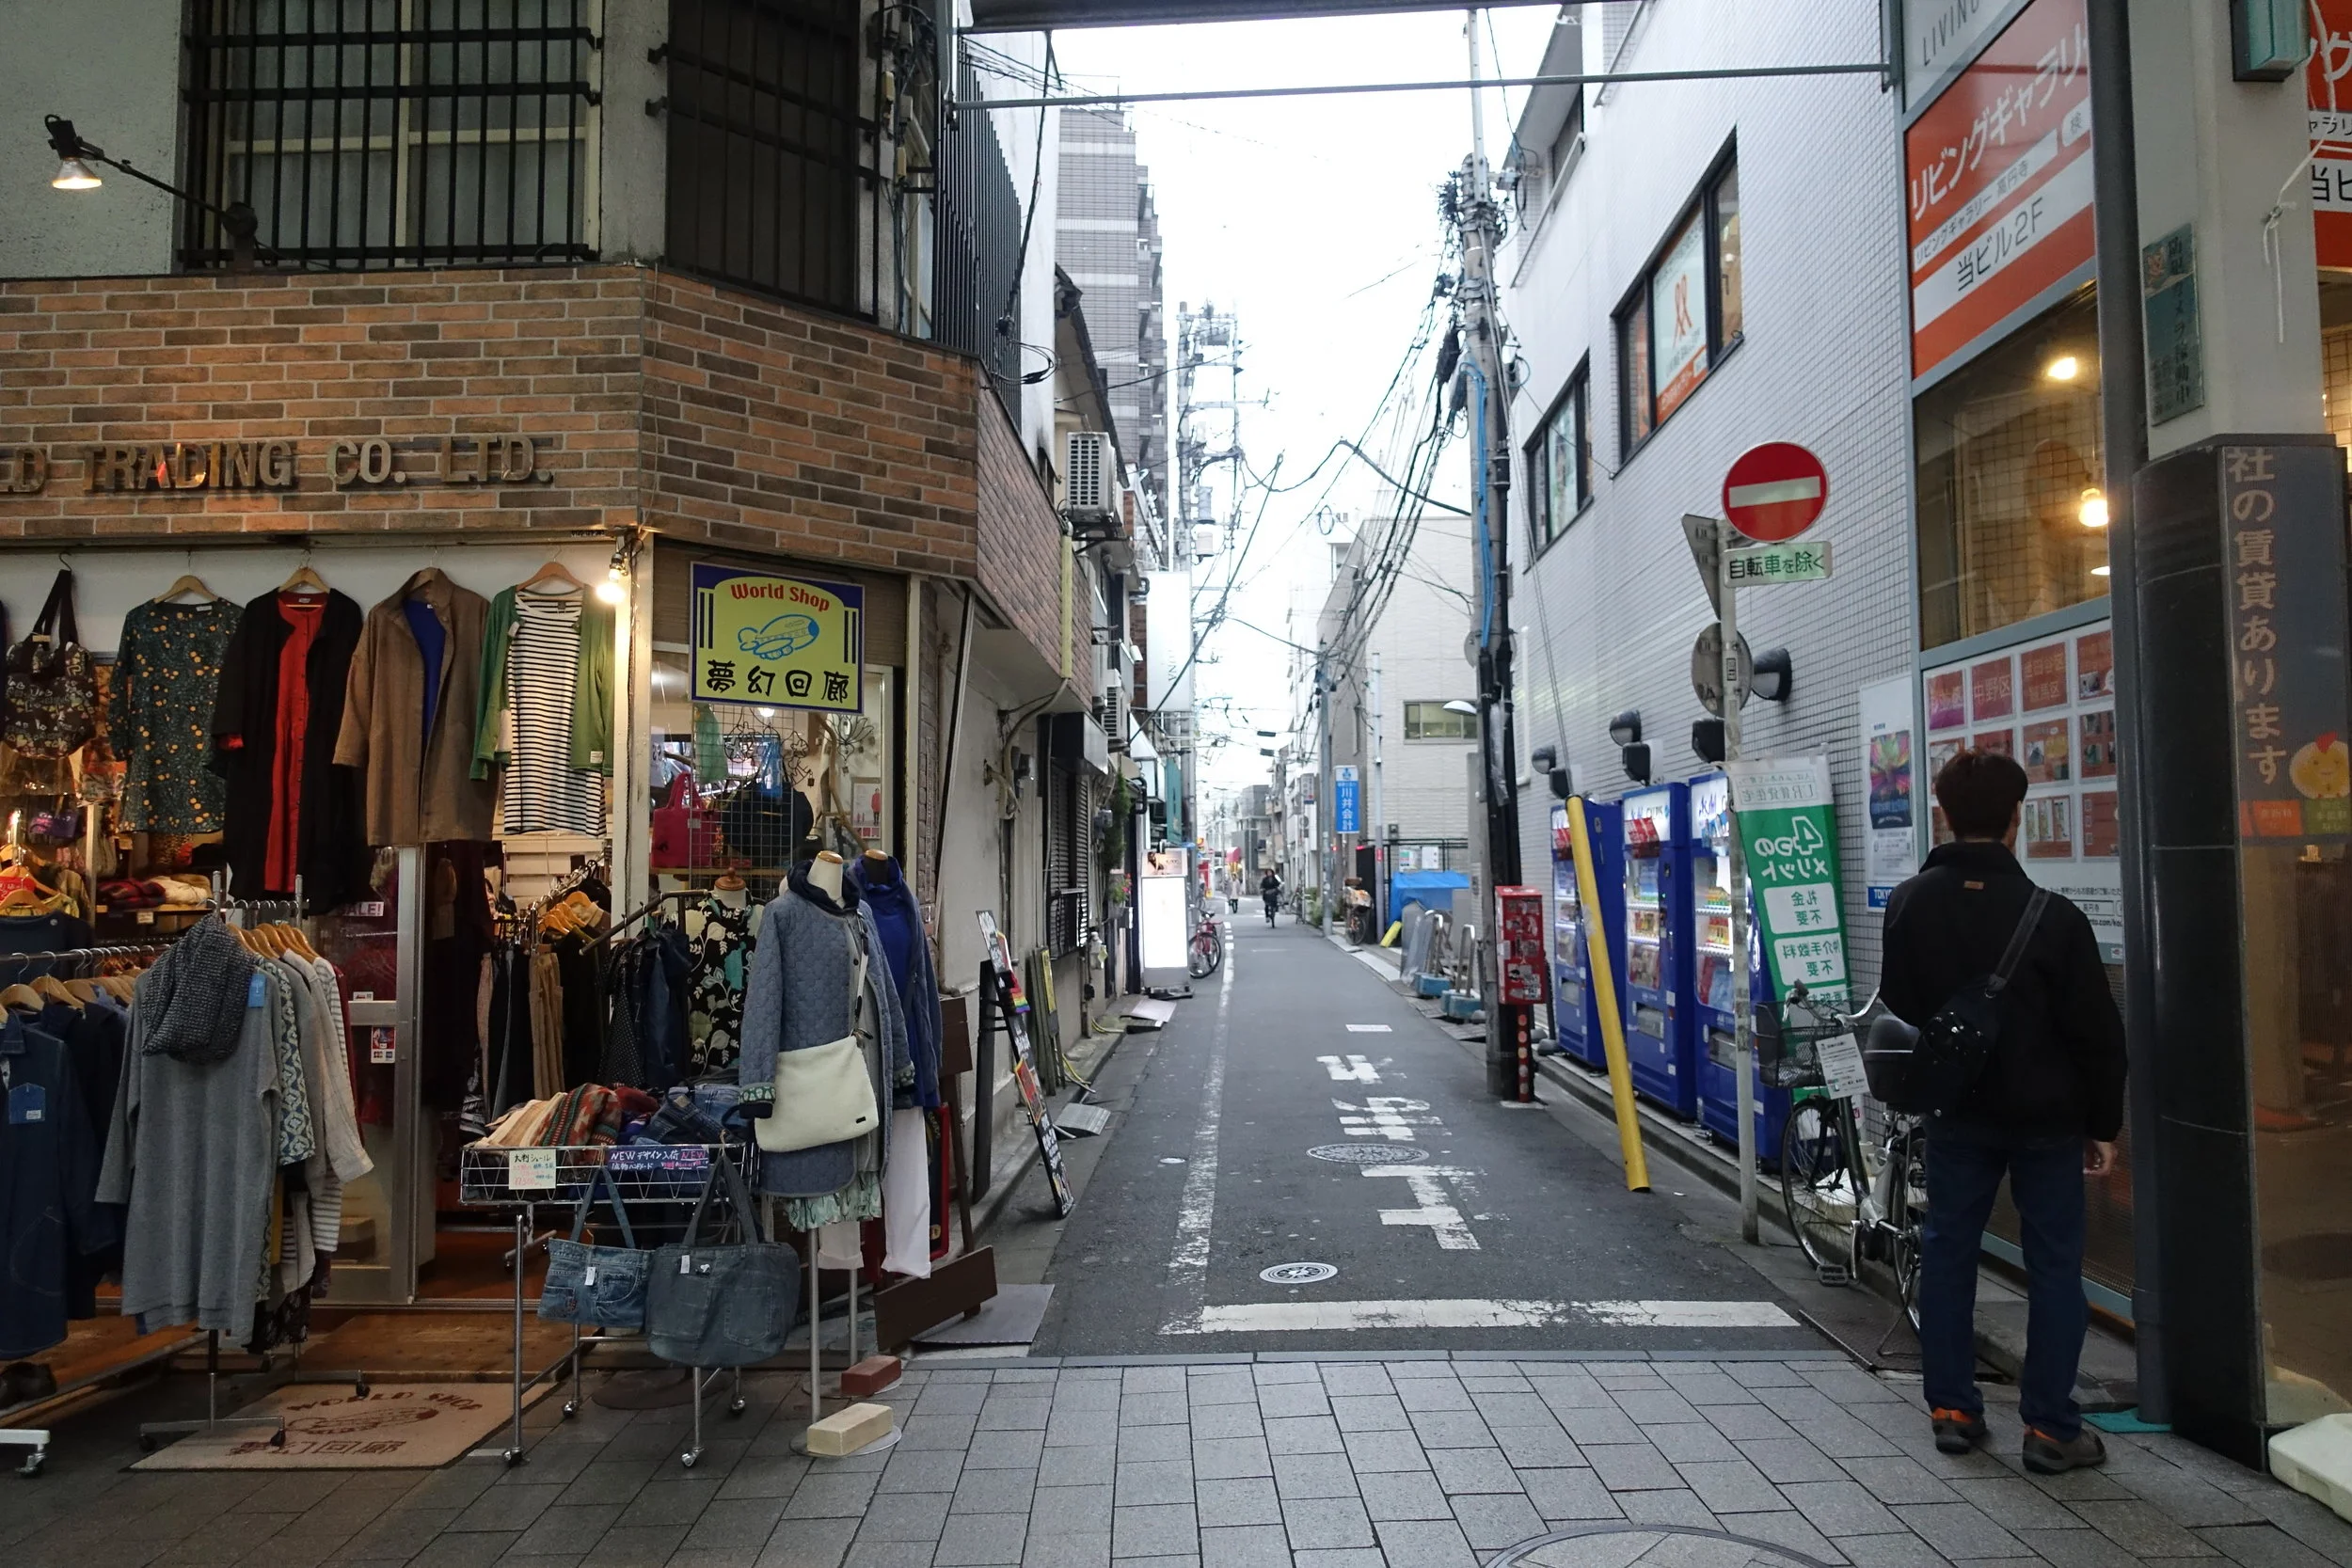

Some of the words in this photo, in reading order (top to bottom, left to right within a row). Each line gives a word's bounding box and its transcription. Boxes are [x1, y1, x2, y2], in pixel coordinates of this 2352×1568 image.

[1957, 195, 2044, 293] 当ビル2F
[82, 440, 296, 494] TRADING
[326, 436, 407, 485] CO.
[440, 432, 554, 484] LTD.
[1729, 551, 1824, 580] 自転車を除く
[730, 582, 786, 601] World
[789, 586, 830, 612] Shop
[706, 658, 850, 704] 夢幻回廊
[1973, 674, 2011, 705] 中野区
[1873, 888, 1892, 900] TOKY
[611, 1150, 635, 1162] NEW
[681, 1150, 707, 1160] NEW
